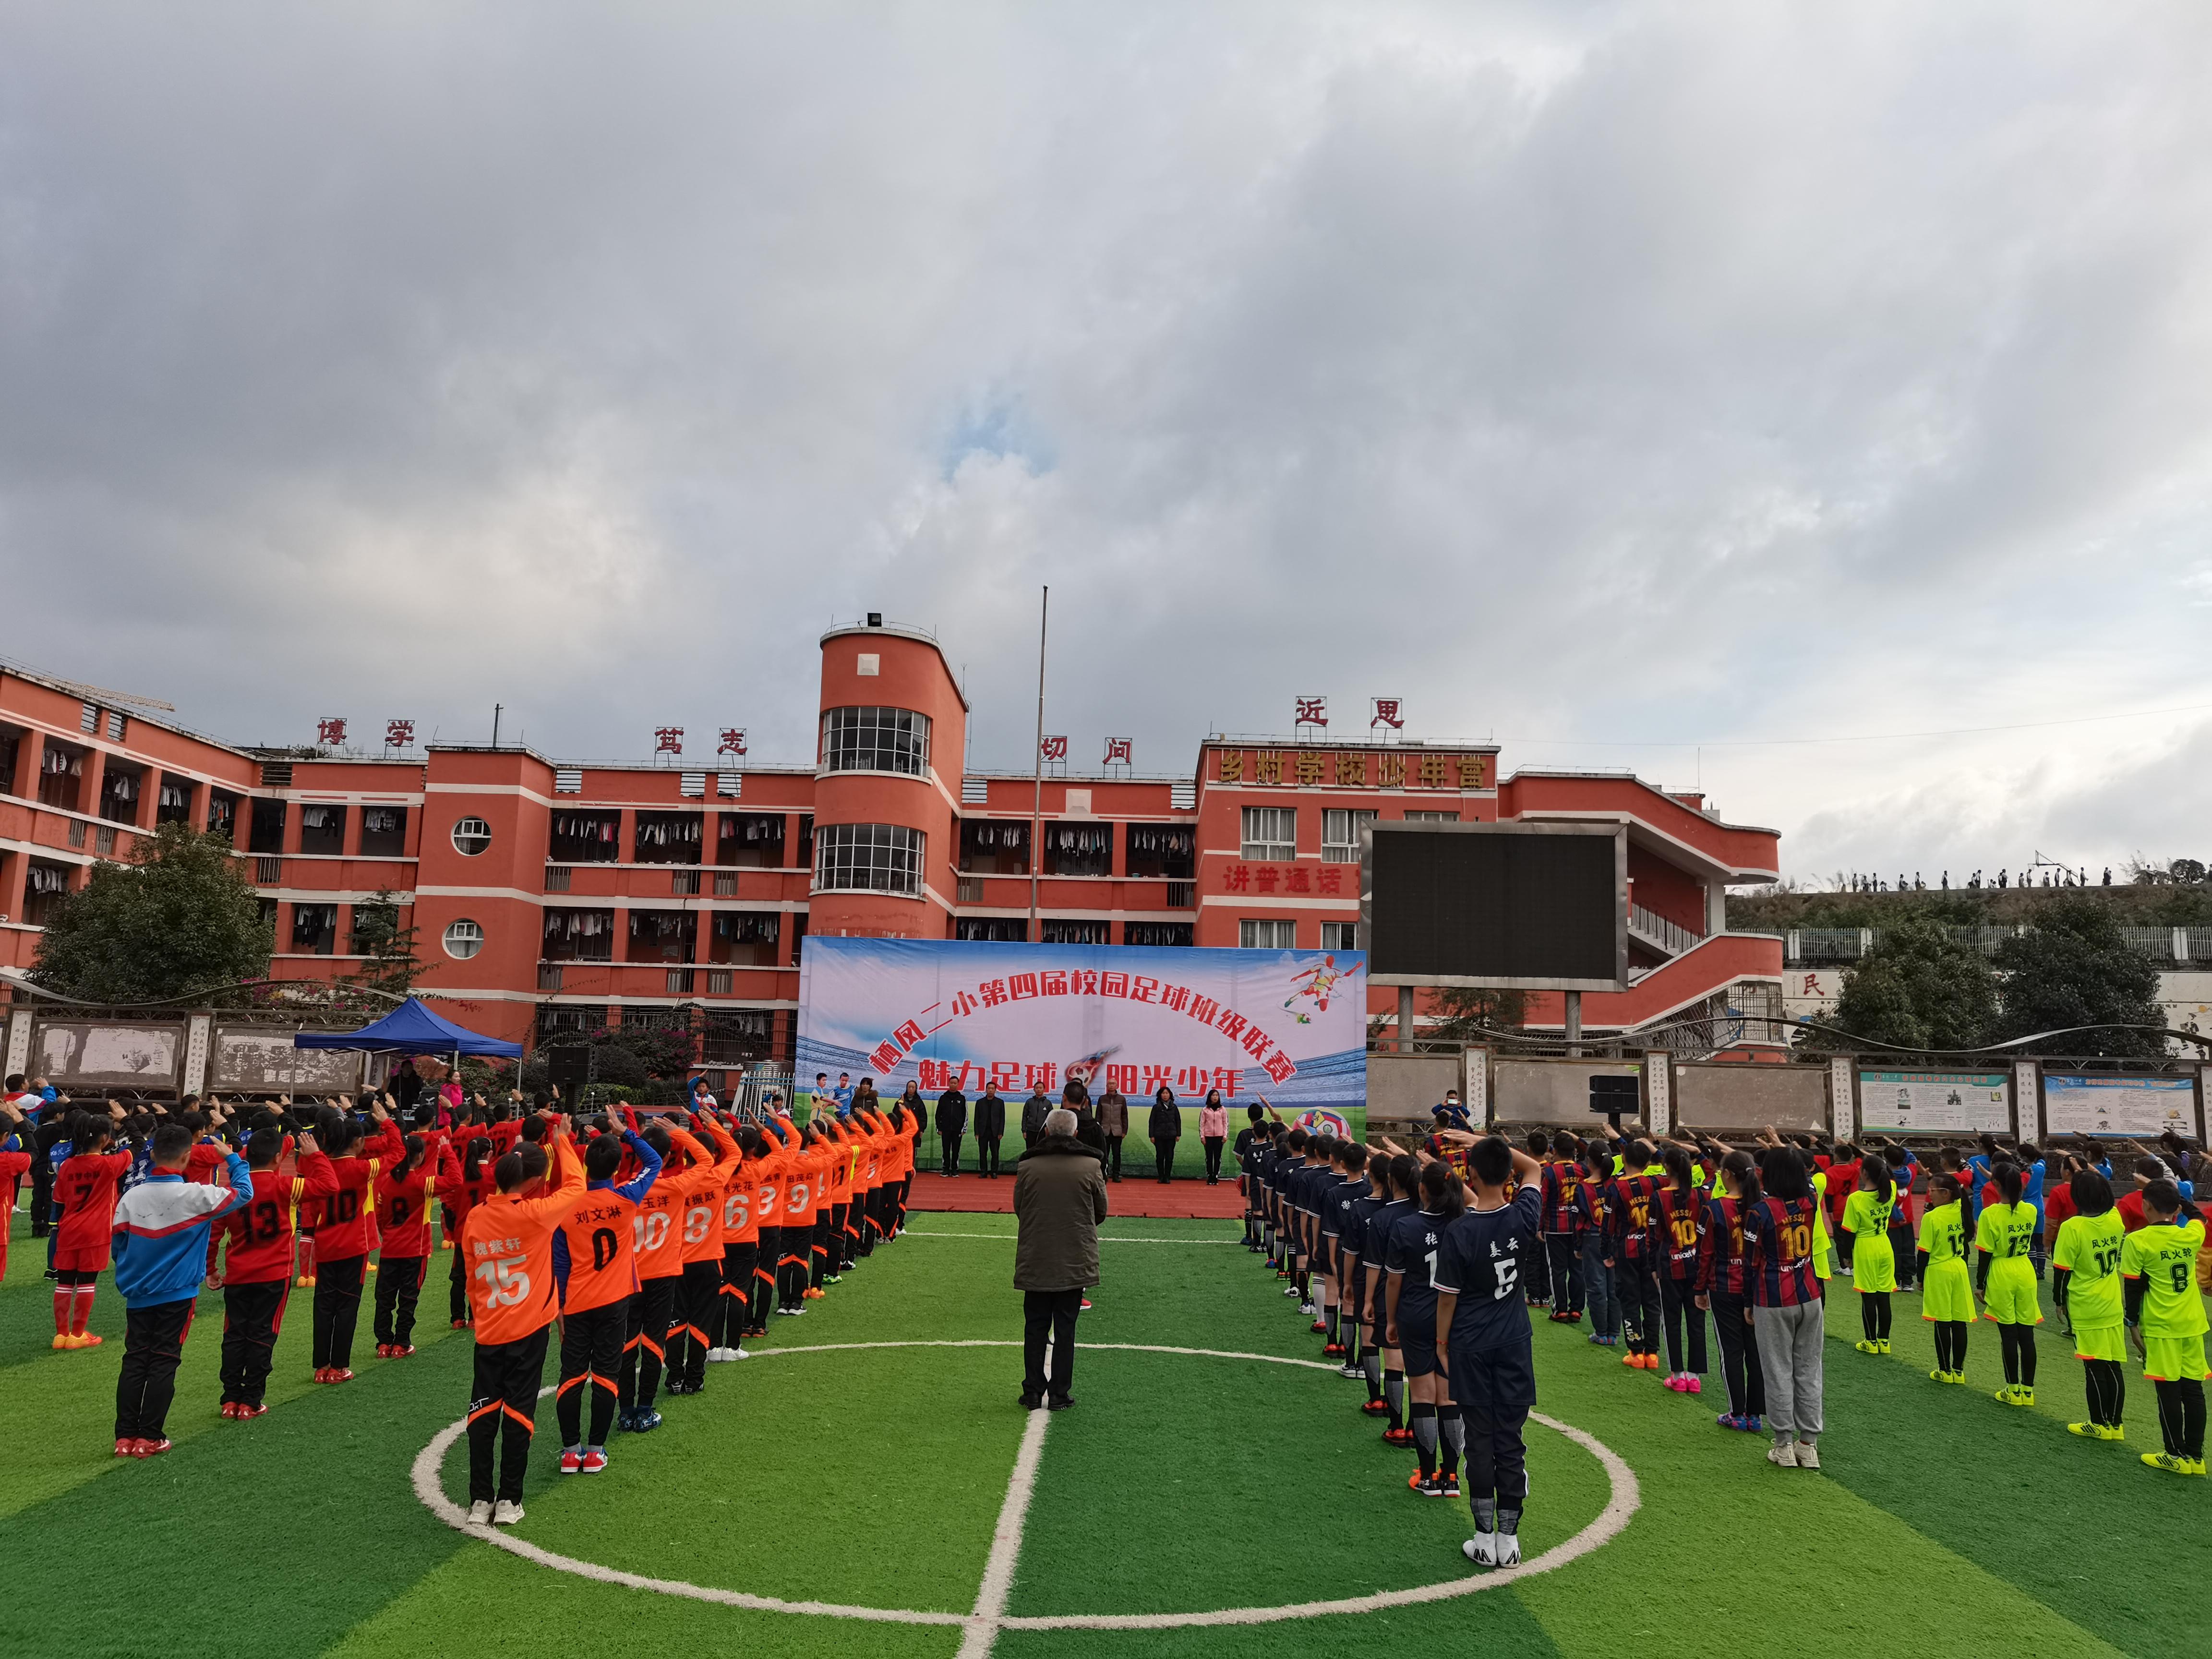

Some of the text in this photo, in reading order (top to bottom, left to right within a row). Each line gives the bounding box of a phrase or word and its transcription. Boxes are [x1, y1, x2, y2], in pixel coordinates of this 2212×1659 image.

[1296, 698, 1404, 728] 近思
[317, 719, 414, 745] 博学
[655, 727, 747, 755] 笃志
[1041, 737, 1131, 764] 切问
[1220, 751, 1487, 788] 乡村学校少年宫
[1223, 866, 1342, 893] 讲普通话
[1803, 973, 1825, 996] 民
[867, 969, 1297, 1087] 栖凤二小第四届校园足球班级联赛
[919, 1059, 1245, 1098] 魅力足球 阳光少年
[74, 1184, 93, 1213] 7
[326, 1189, 358, 1226] 10
[724, 1194, 749, 1229] 6
[758, 1186, 776, 1216] 3
[787, 1184, 809, 1213] 9
[1629, 1196, 1649, 1206] MESSI
[1869, 1206, 1890, 1217] 风火轮
[240, 1202, 280, 1244] 13
[574, 1205, 623, 1225] 刘文淋
[685, 1206, 712, 1243] 8
[1670, 1210, 1693, 1220] MESSI
[1781, 1214, 1805, 1225] MESSI
[1948, 1223, 1964, 1233] 风火
[2008, 1222, 2032, 1233] 风火轮
[474, 1237, 522, 1256] 魏紫轩
[633, 1212, 671, 1252] 10
[1671, 1219, 1697, 1250] 10
[1780, 1225, 1810, 1260] 10
[2007, 1233, 2031, 1258] 13
[2092, 1235, 2118, 1249] 风火轮
[591, 1227, 618, 1272] 0
[2093, 1248, 2118, 1278] 10
[2160, 1247, 2192, 1261] 风火轮
[475, 1254, 530, 1309] 15
[2170, 1262, 2189, 1295] 8
